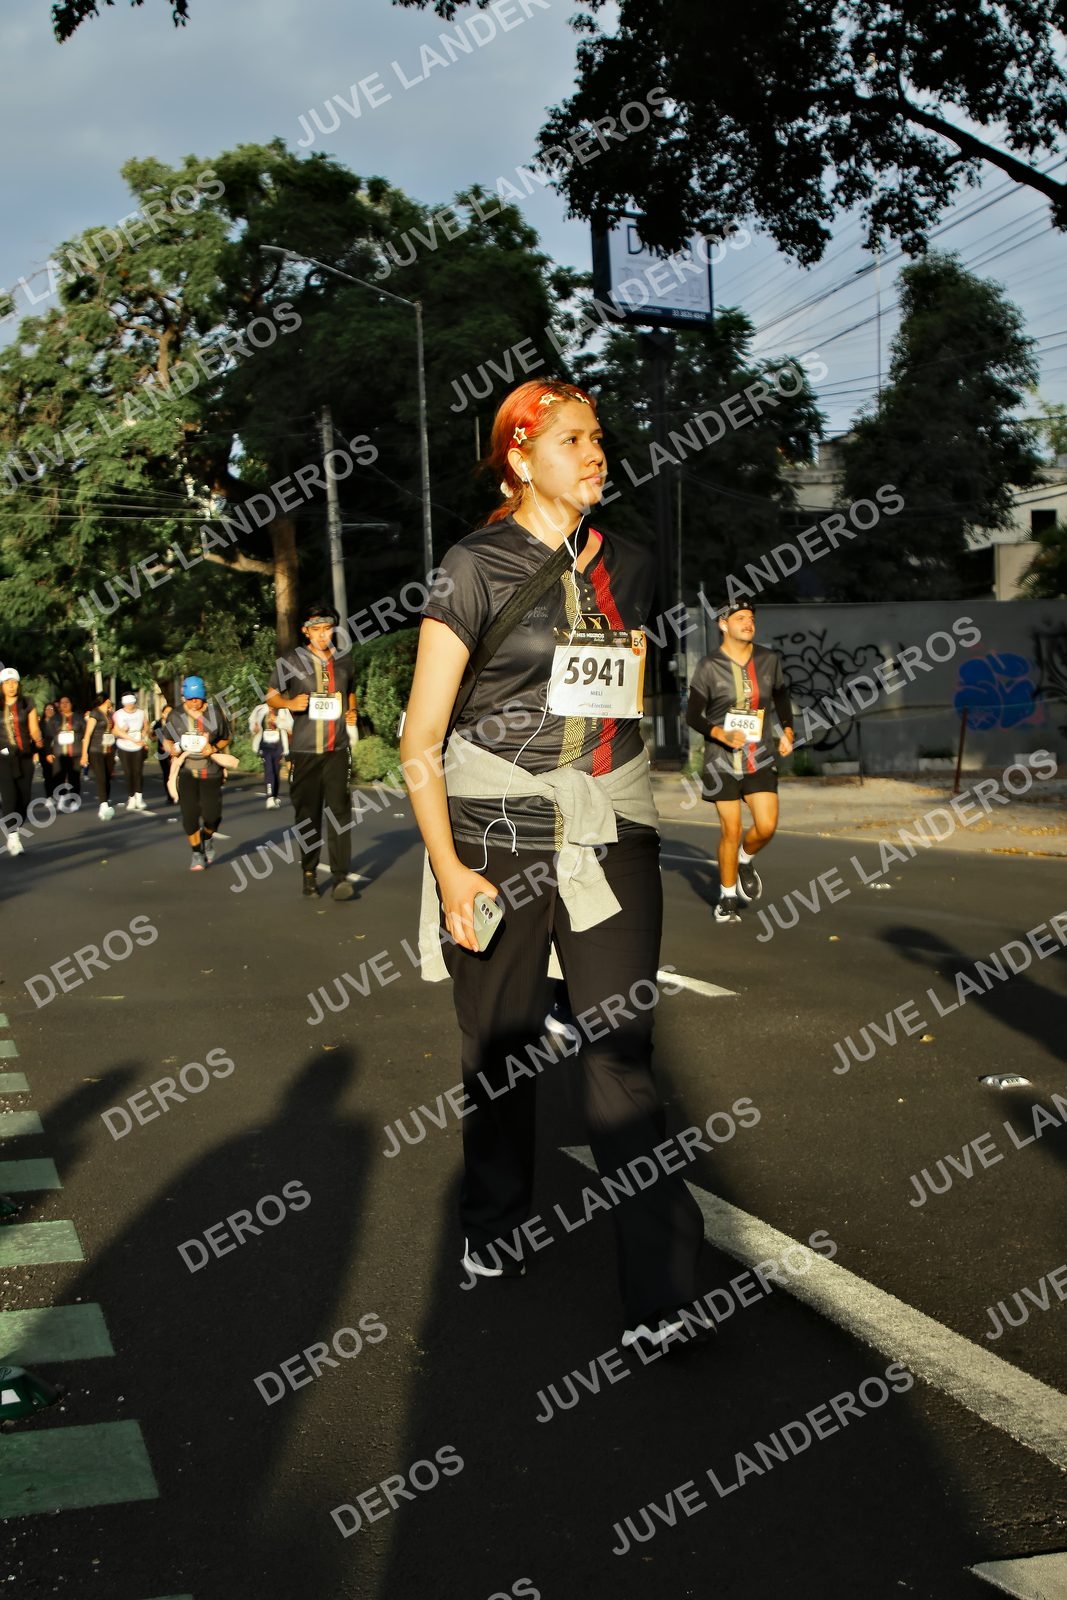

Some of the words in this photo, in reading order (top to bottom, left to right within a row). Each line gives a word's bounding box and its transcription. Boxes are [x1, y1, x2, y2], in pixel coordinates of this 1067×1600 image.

[772, 628, 828, 651] TOY
[564, 656, 625, 687] 5941
[314, 701, 334, 710] 6201
[730, 719, 755, 729] 6486
